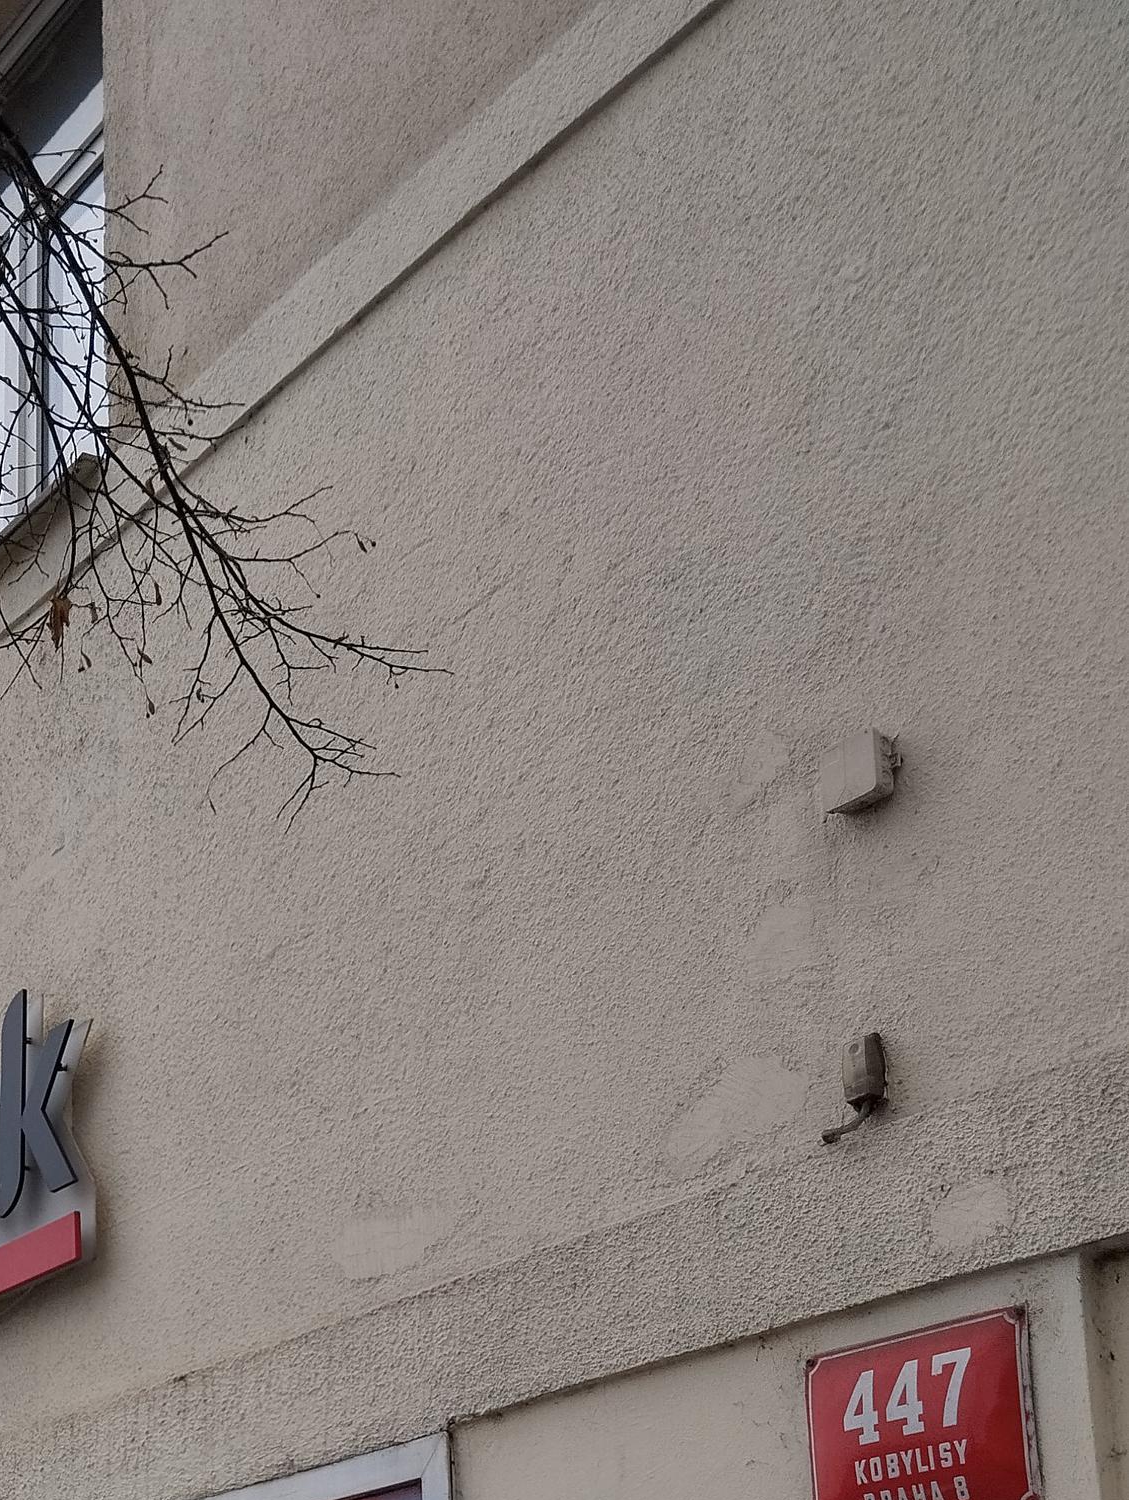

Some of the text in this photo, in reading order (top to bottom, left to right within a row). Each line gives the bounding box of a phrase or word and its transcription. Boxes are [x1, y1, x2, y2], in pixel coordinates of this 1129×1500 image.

[843, 1347, 972, 1446] 447
[854, 1439, 968, 1486] KOBYLISY
[953, 1475, 970, 1500] 8
